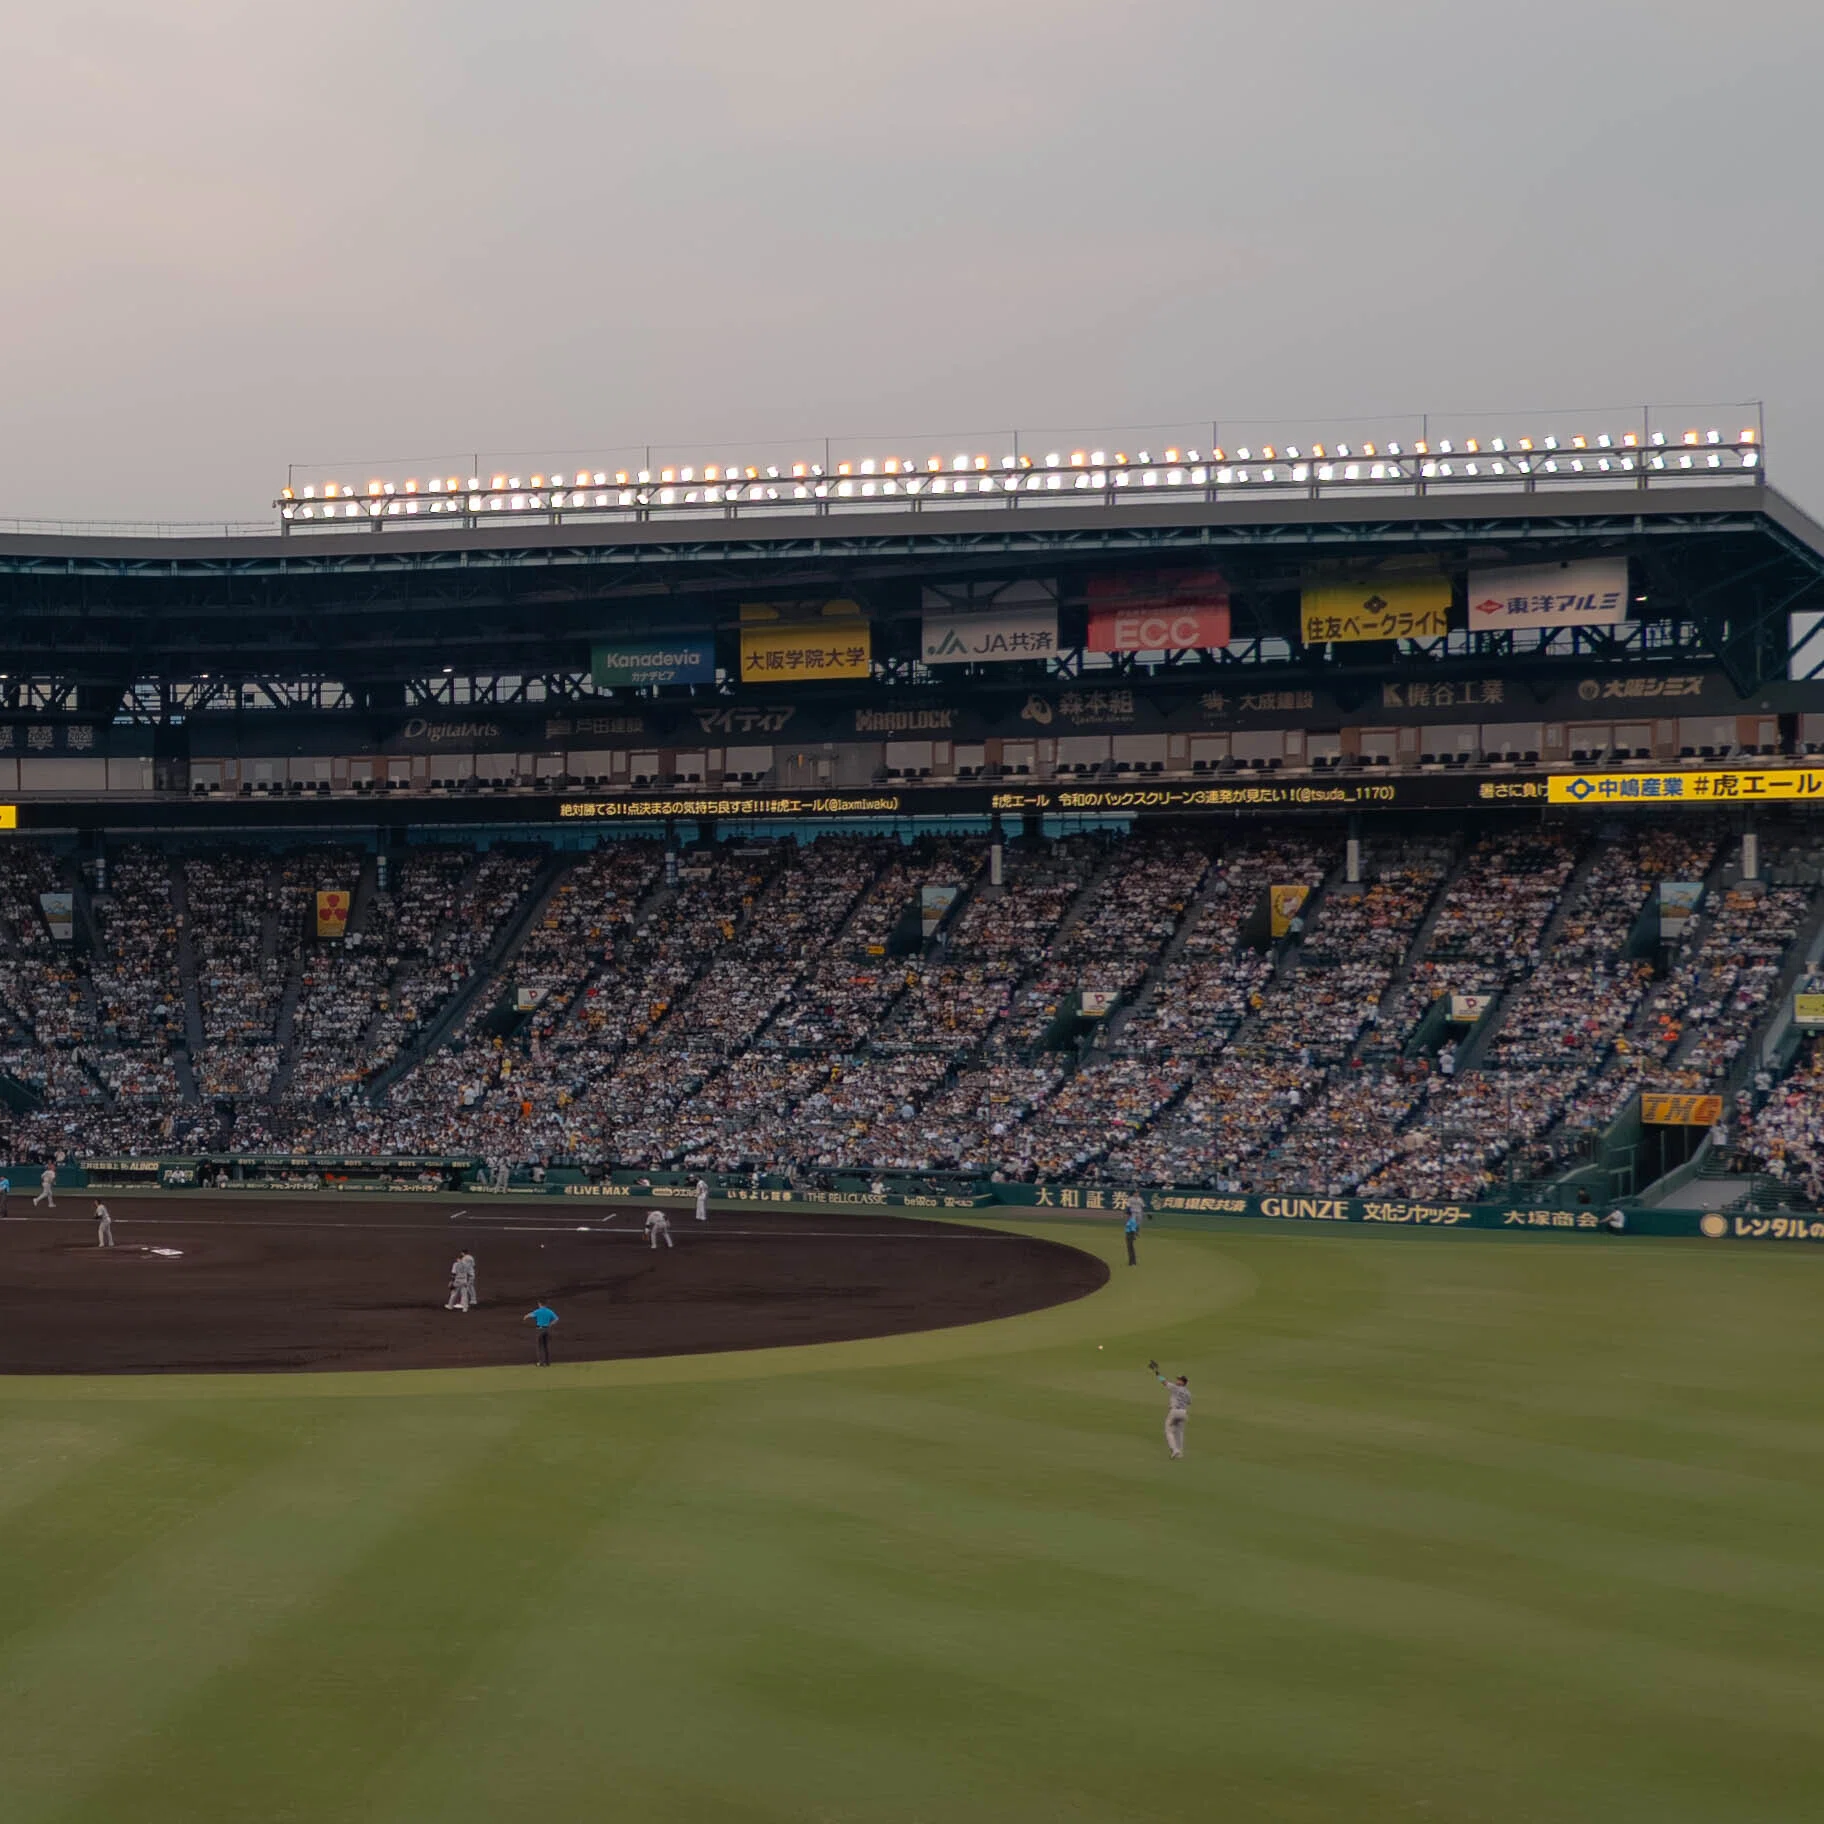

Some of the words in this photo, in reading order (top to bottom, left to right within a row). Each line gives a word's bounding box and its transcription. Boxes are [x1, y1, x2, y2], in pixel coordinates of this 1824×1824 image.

[1506, 592, 1622, 617] 東洋アルミ
[1114, 615, 1200, 650] ECC
[1306, 612, 1448, 642] 住友ベークライト
[972, 630, 1055, 657] JA共済
[606, 648, 702, 669] Kanadevia
[744, 646, 866, 673] 大阪学院大学
[1058, 689, 1134, 714] 森本組
[690, 705, 798, 735] マイティア
[1597, 776, 1684, 798] 中嶋産業
[1693, 772, 1823, 797] #虎エール
[601, 1184, 631, 1196] MAX
[806, 1190, 827, 1203] THE
[1260, 1197, 1350, 1221] GUNZE
[1502, 1208, 1599, 1228] 大塚商会
